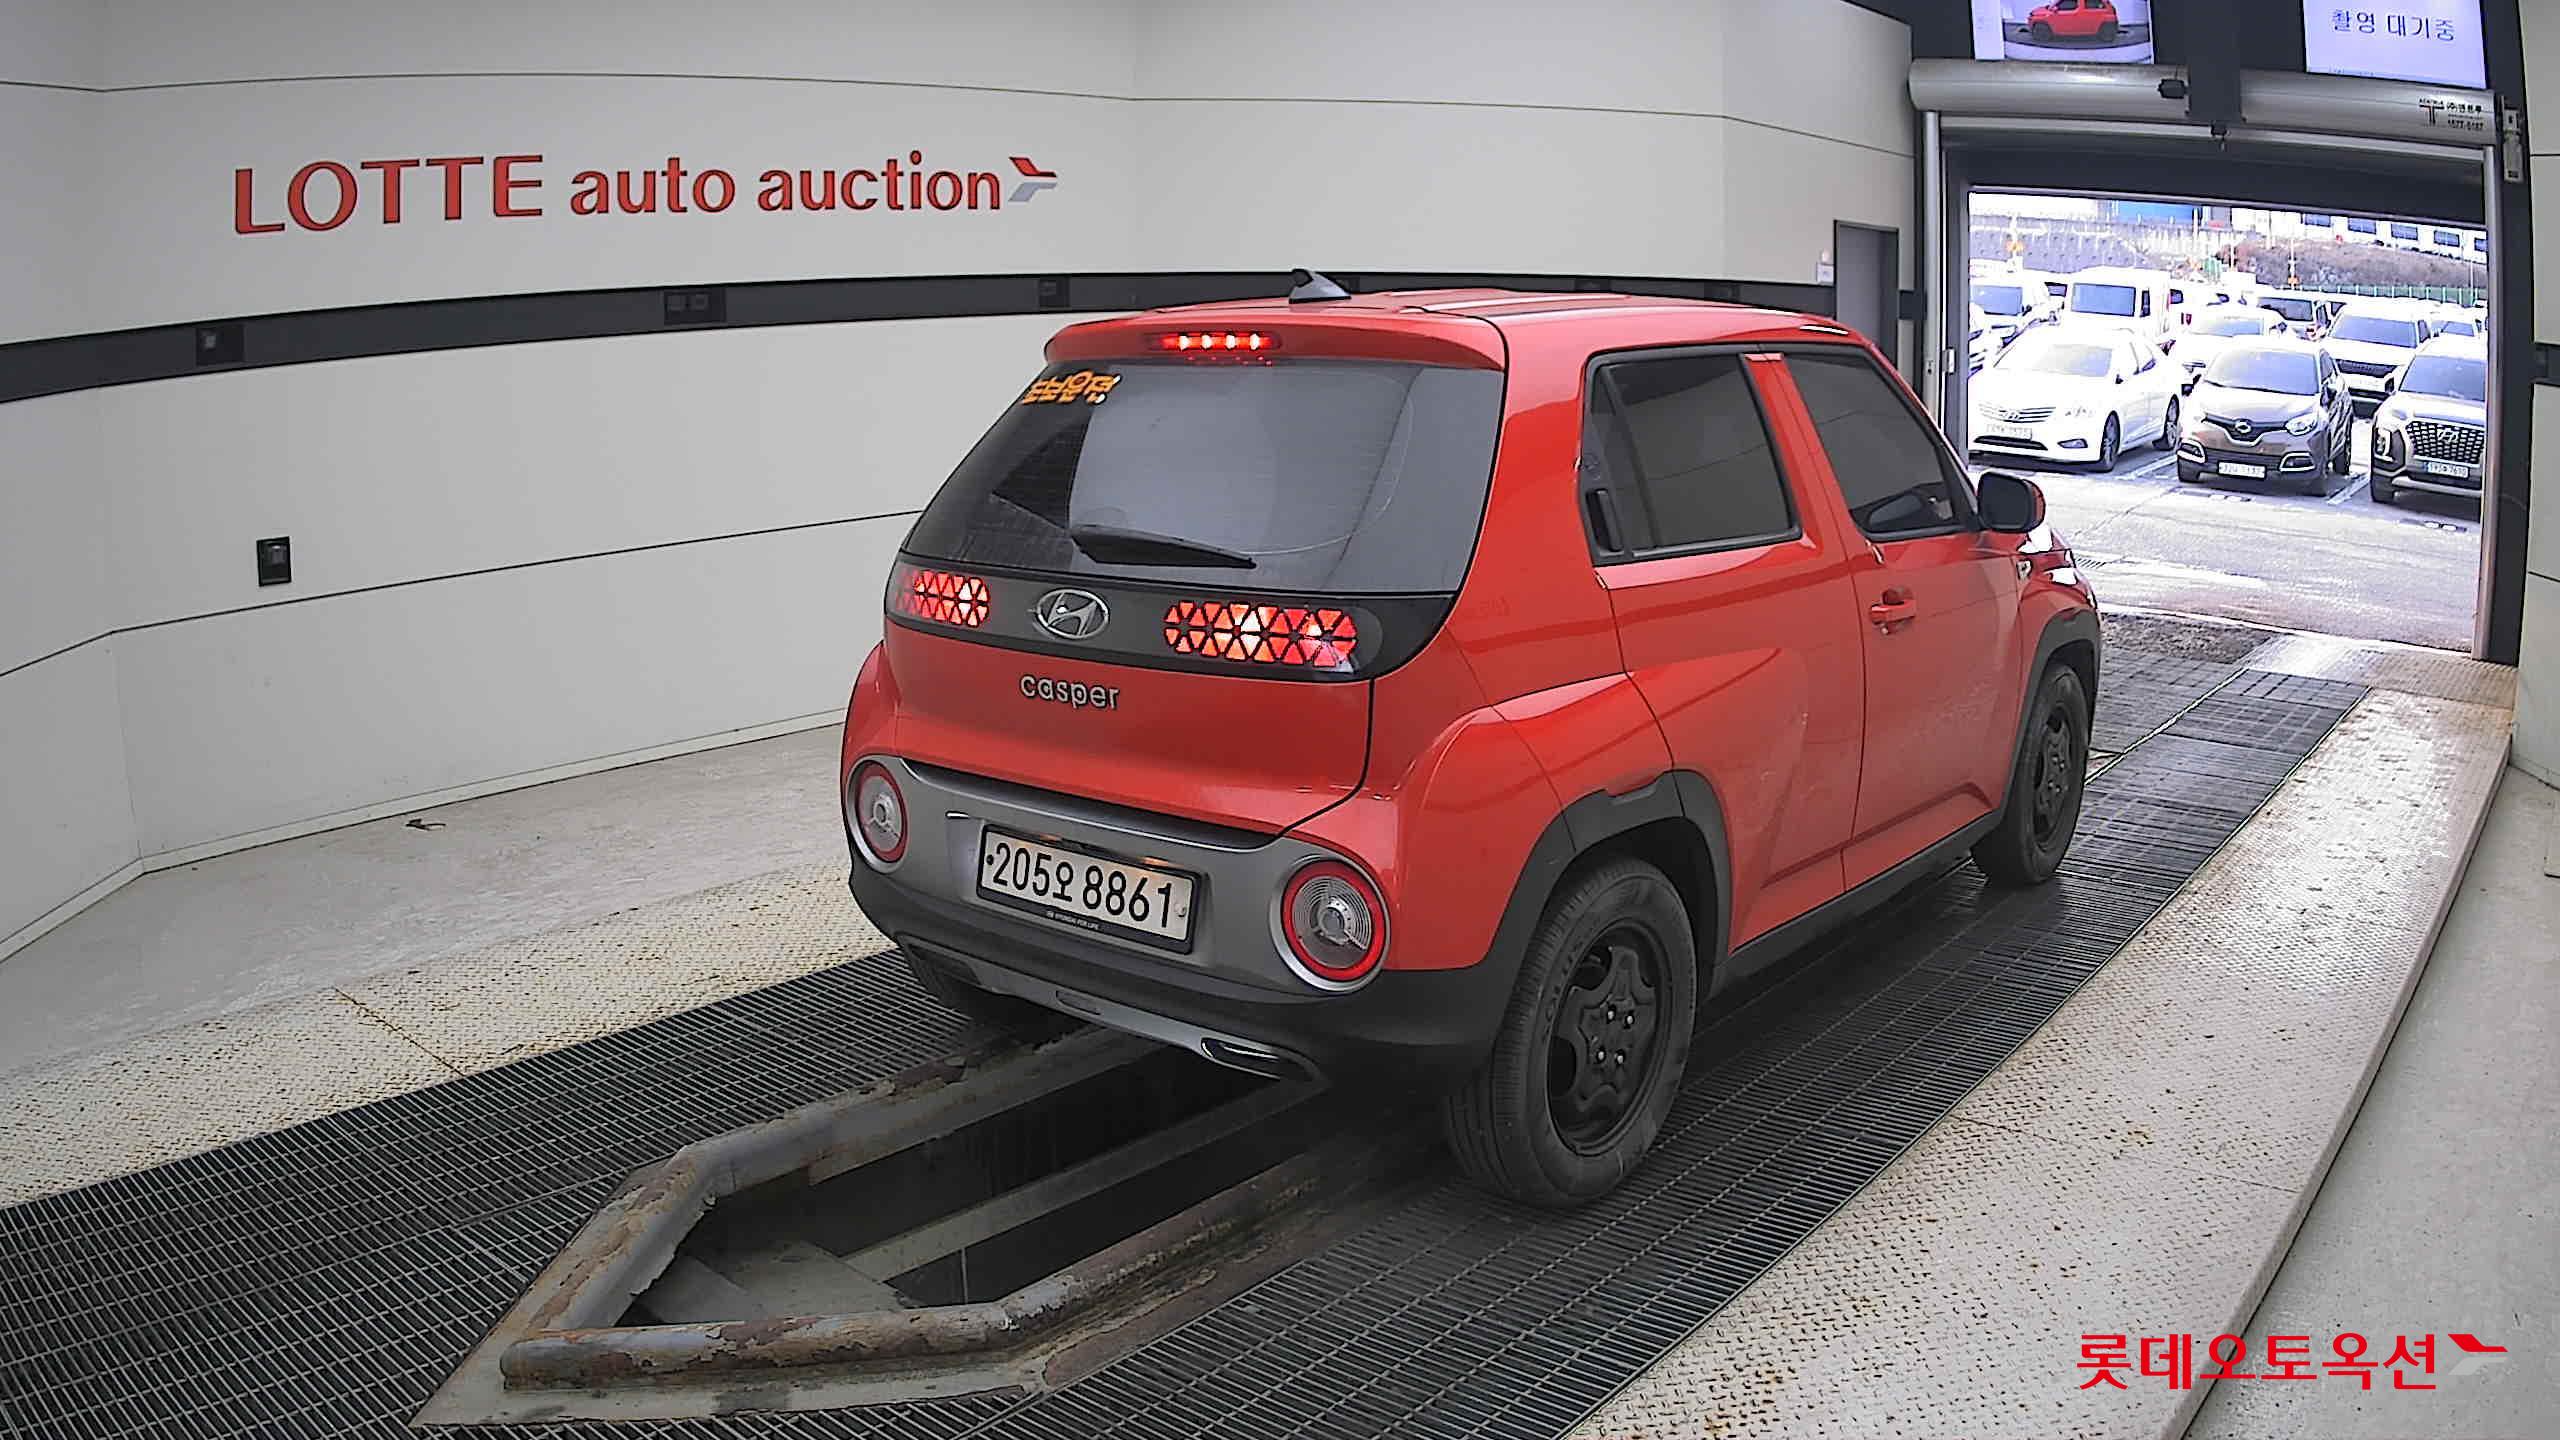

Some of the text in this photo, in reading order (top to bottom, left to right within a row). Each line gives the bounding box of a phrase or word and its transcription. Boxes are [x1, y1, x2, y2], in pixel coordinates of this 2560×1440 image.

[2333, 9, 2455, 41] 촬영 대기중
[236, 151, 1001, 233] LOTTE auto auction
[1020, 674, 1120, 709] casper
[993, 842, 1173, 928] 205오 8861
